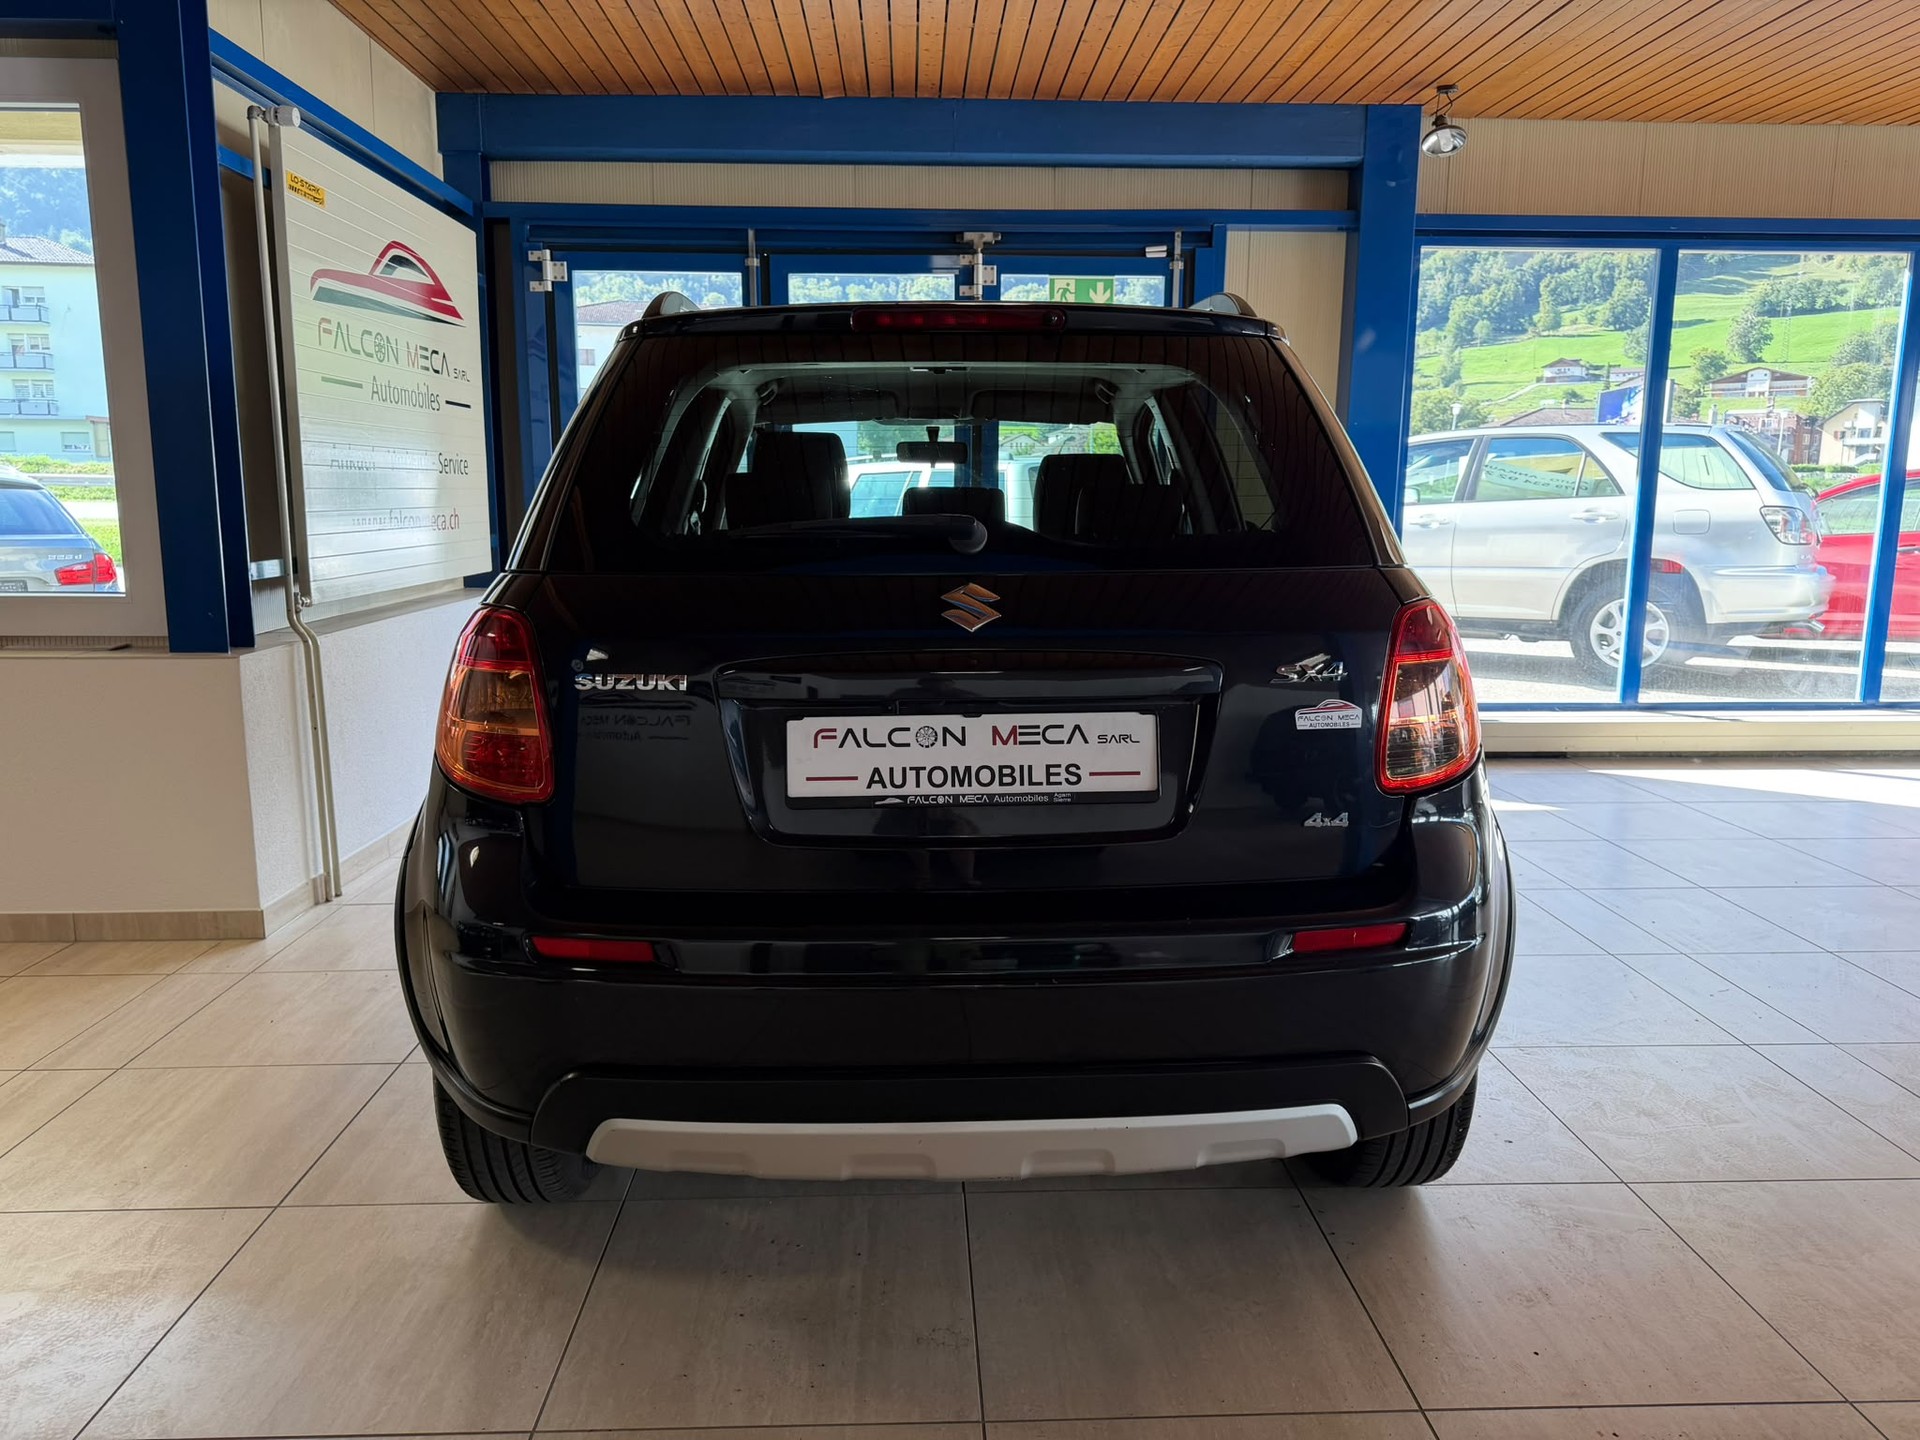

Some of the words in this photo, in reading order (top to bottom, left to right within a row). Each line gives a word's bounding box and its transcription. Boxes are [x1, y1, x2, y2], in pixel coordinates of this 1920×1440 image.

[318, 317, 400, 364] FALCON
[406, 341, 451, 378] MECA
[453, 368, 471, 383] SARL
[371, 375, 441, 412] Automobiles
[438, 452, 469, 476] Service
[1270, 653, 1348, 683] SX4
[574, 673, 688, 691] SUZUKI
[813, 725, 967, 749] FALCON
[991, 723, 1090, 747] MECA
[1097, 733, 1141, 744] SARL
[866, 763, 1082, 790] AUTOMOBILES
[907, 796, 953, 805] FALCON
[959, 795, 989, 804] MECA
[993, 794, 1049, 804] Automobiles
[1304, 812, 1349, 828] 4x4
